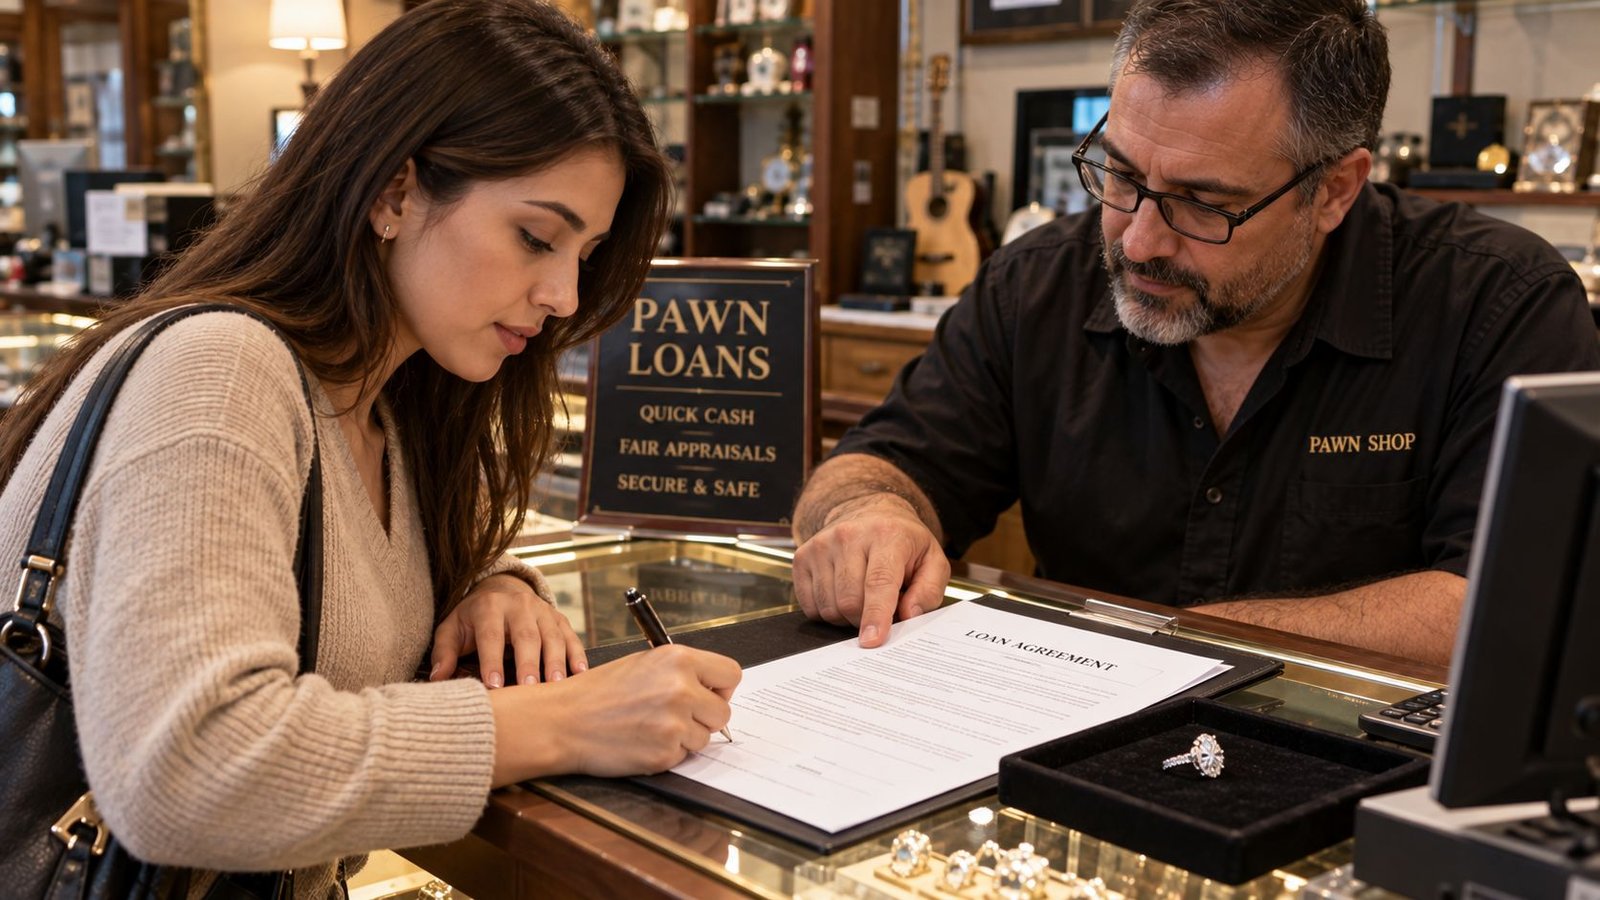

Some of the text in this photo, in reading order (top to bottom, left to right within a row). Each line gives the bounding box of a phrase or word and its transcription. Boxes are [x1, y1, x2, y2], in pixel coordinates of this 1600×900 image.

[631, 298, 770, 336] PAWN
[628, 342, 770, 380] LOANS
[639, 405, 755, 426] QUICK CASH
[619, 438, 777, 462] FAIR APPRAISALS
[1309, 433, 1416, 453] PAWN SHOP
[617, 473, 760, 498] SECURE & SAFE
[965, 630, 1012, 645] LOAN
[1012, 642, 1118, 671] AGREEMENT
